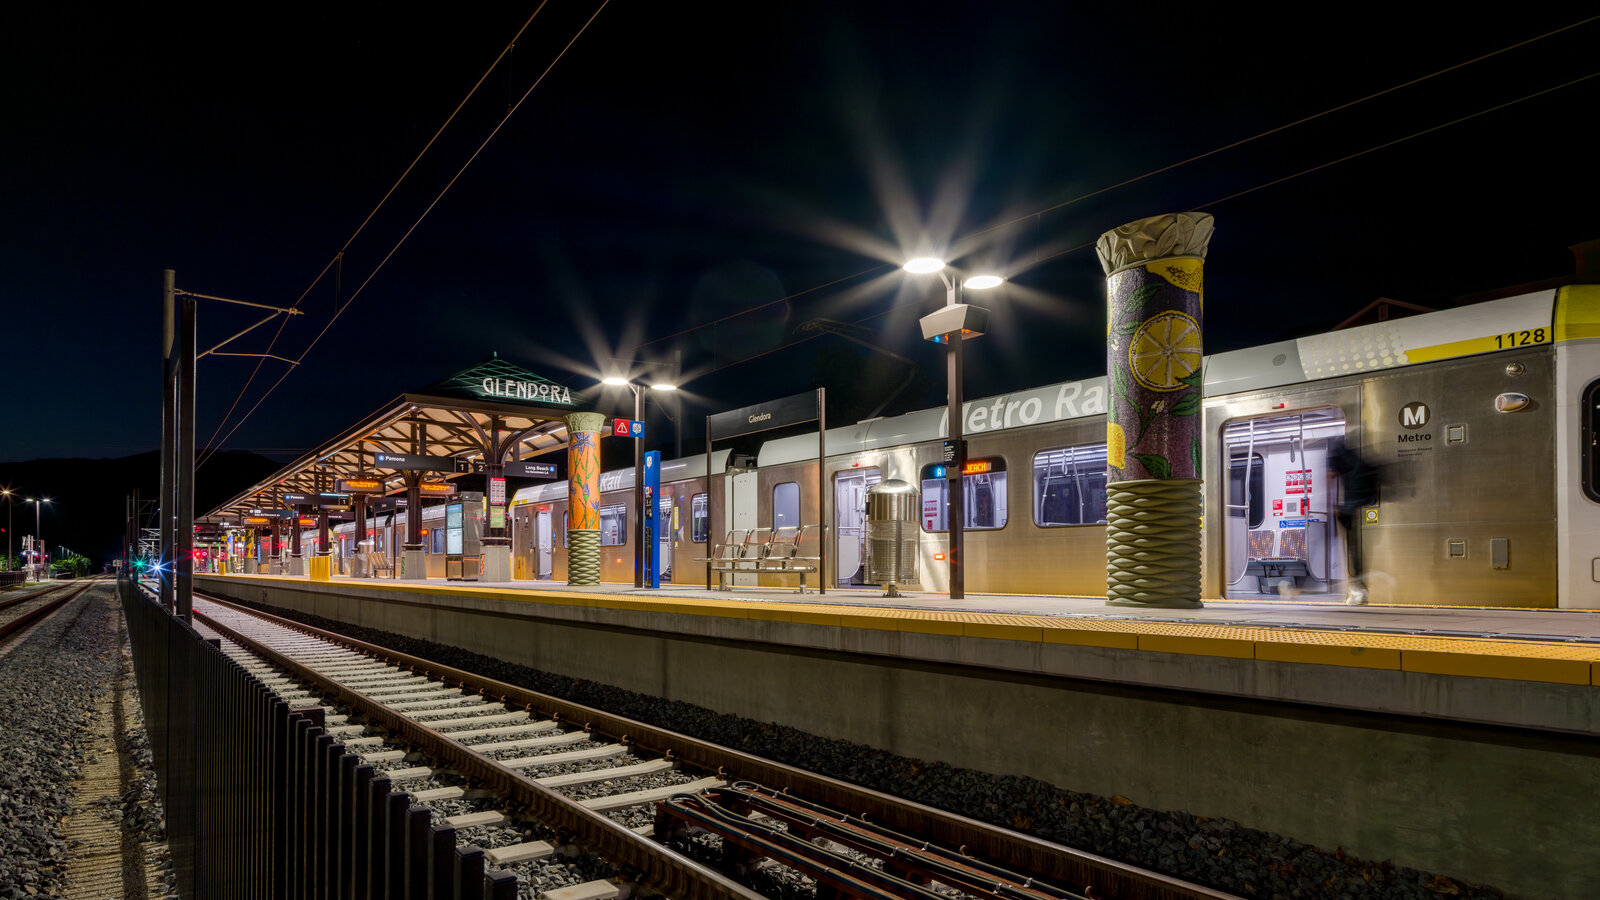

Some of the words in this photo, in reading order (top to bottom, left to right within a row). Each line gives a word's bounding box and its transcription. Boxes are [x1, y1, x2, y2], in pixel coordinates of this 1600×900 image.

[1494, 328, 1545, 349] 1128
[482, 377, 571, 404] GLENDORA
[748, 412, 771, 424] Glendora
[1403, 405, 1425, 426] M
[1397, 433, 1432, 443] Metro
[600, 470, 624, 492] Rail
